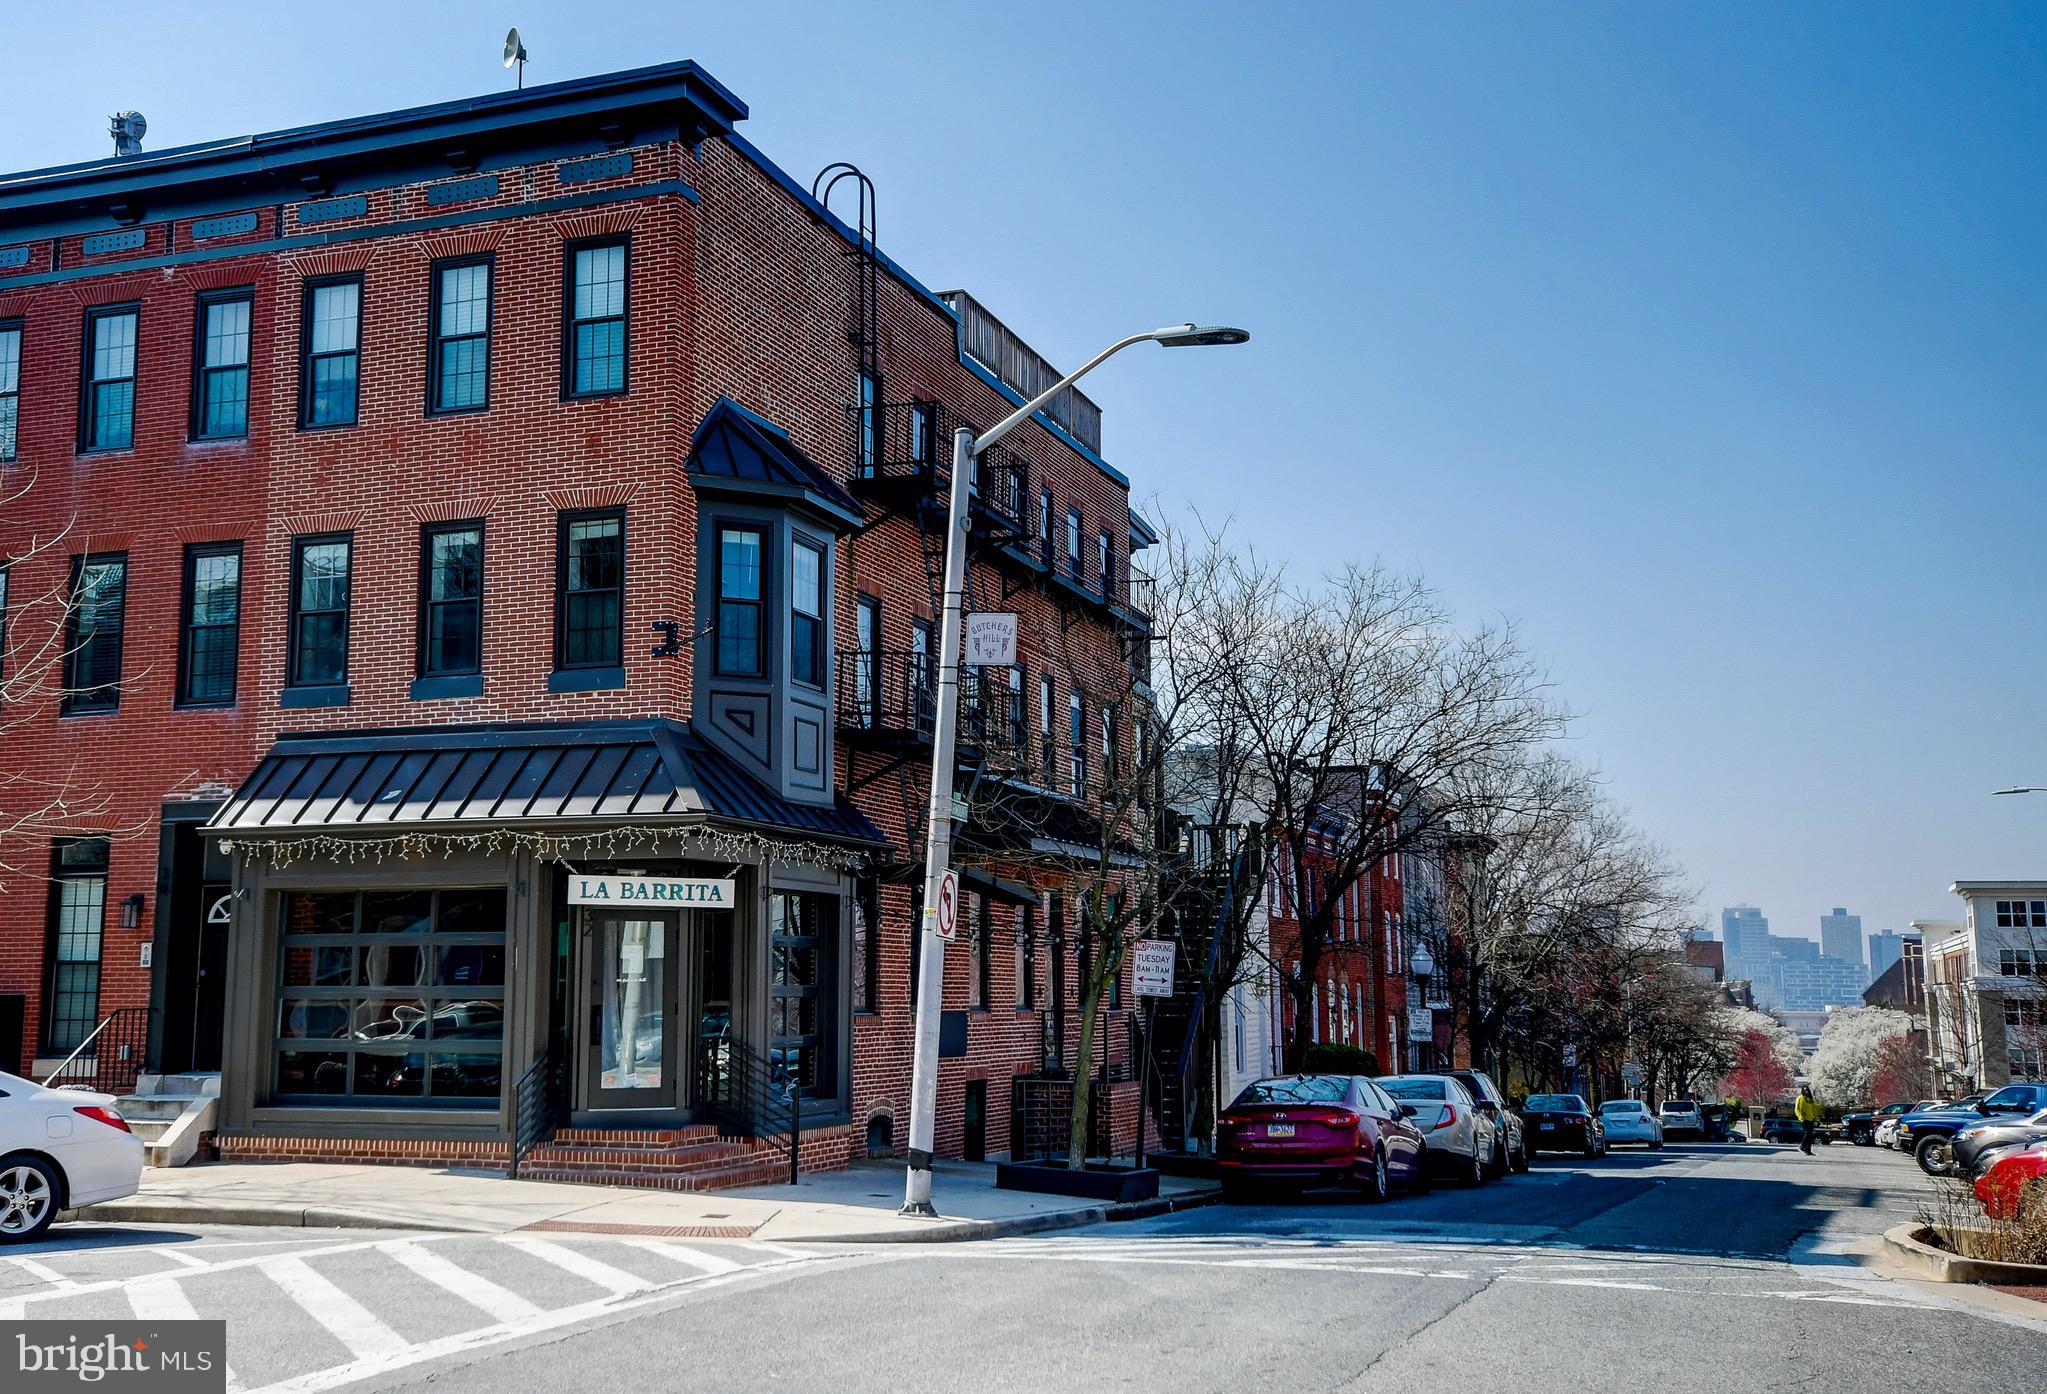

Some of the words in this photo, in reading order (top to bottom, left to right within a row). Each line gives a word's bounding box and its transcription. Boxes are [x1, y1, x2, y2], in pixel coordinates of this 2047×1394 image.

[982, 634, 1000, 643] HILL
[580, 881, 610, 899] LA
[620, 882, 723, 902] BARRITA
[1136, 941, 1146, 951] NO
[1147, 943, 1172, 952] PARKING
[1138, 954, 1170, 964] TUESDAY
